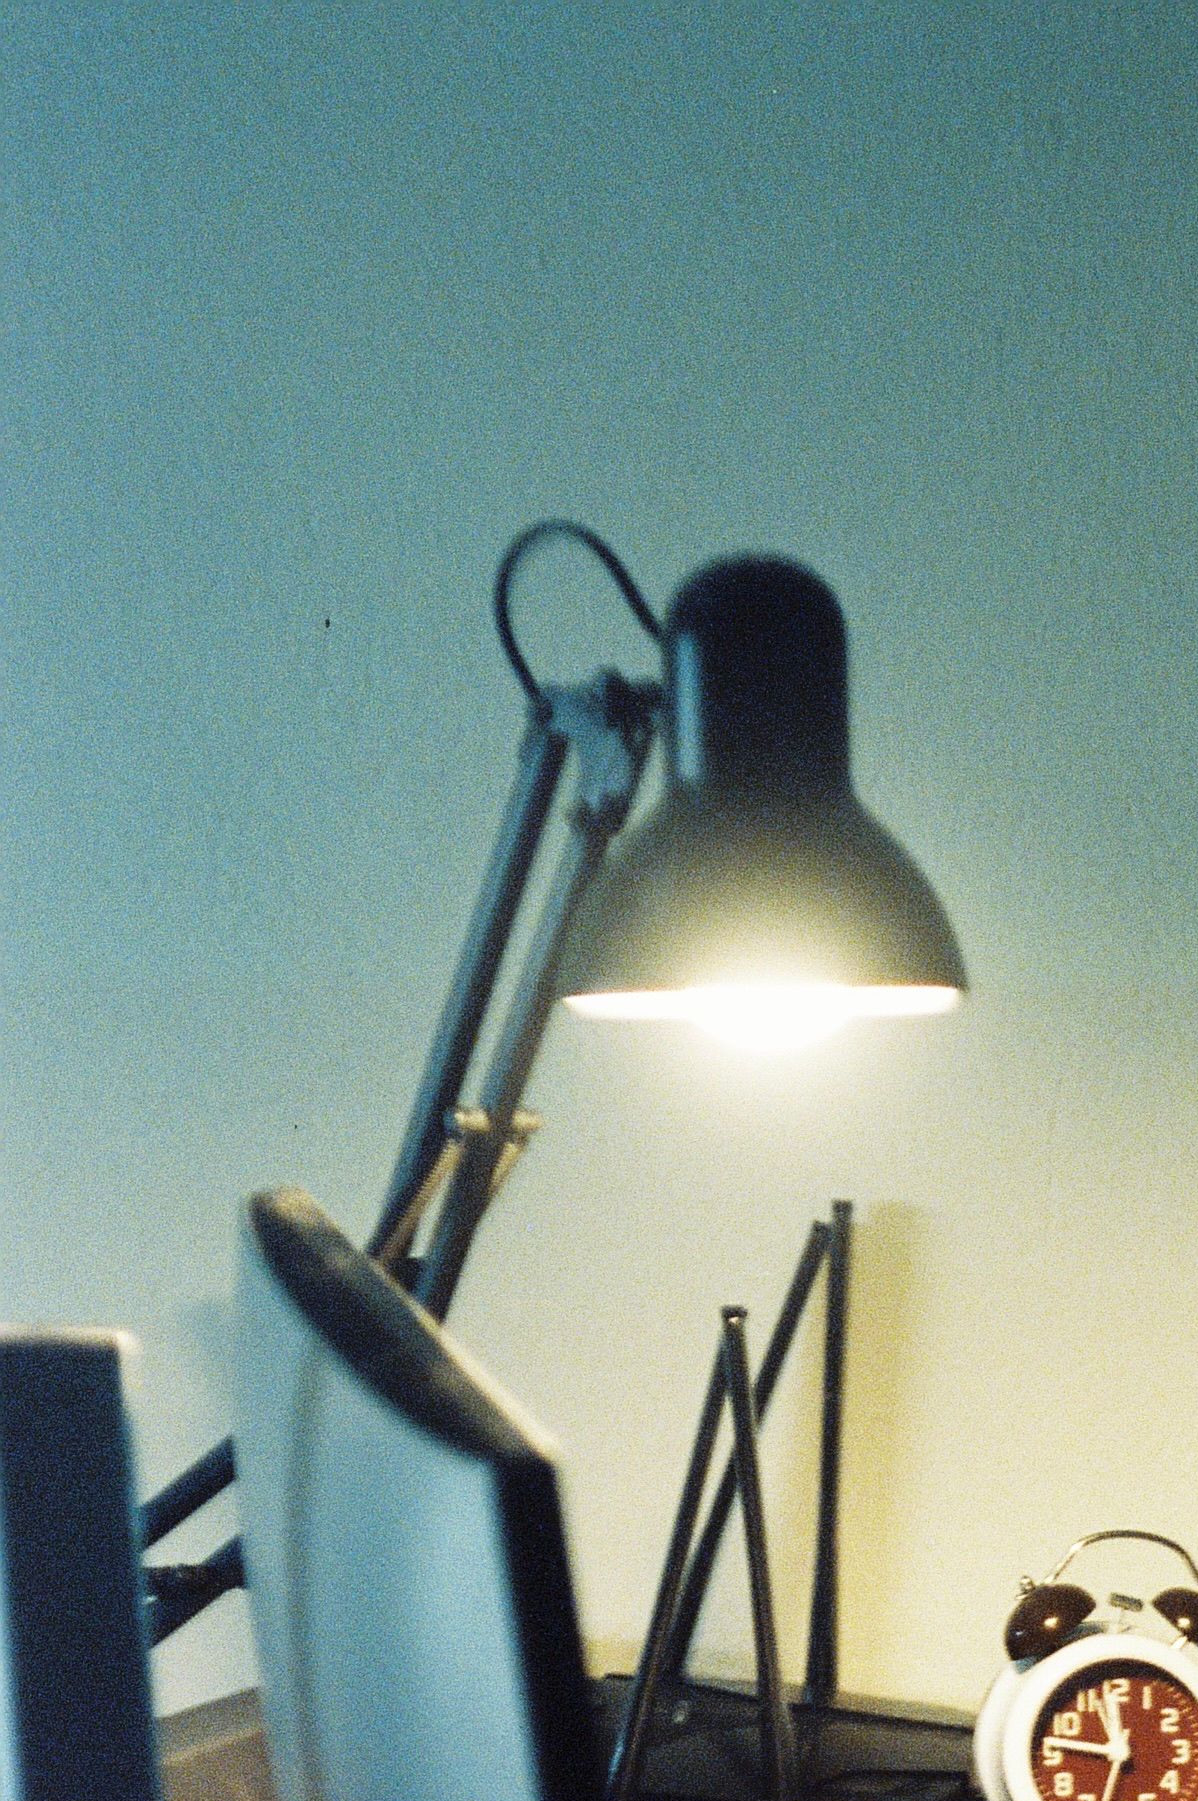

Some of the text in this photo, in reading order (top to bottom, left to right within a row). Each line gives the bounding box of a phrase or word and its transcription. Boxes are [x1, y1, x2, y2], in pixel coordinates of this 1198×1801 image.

[1077, 1688, 1098, 1712] 11
[1142, 1686, 1151, 1710] 1
[1054, 1712, 1081, 1736] 10
[1160, 1708, 1180, 1733] 2
[1171, 1739, 1191, 1764] 3
[1054, 1772, 1074, 1797] 8
[1159, 1770, 1180, 1794] 4
